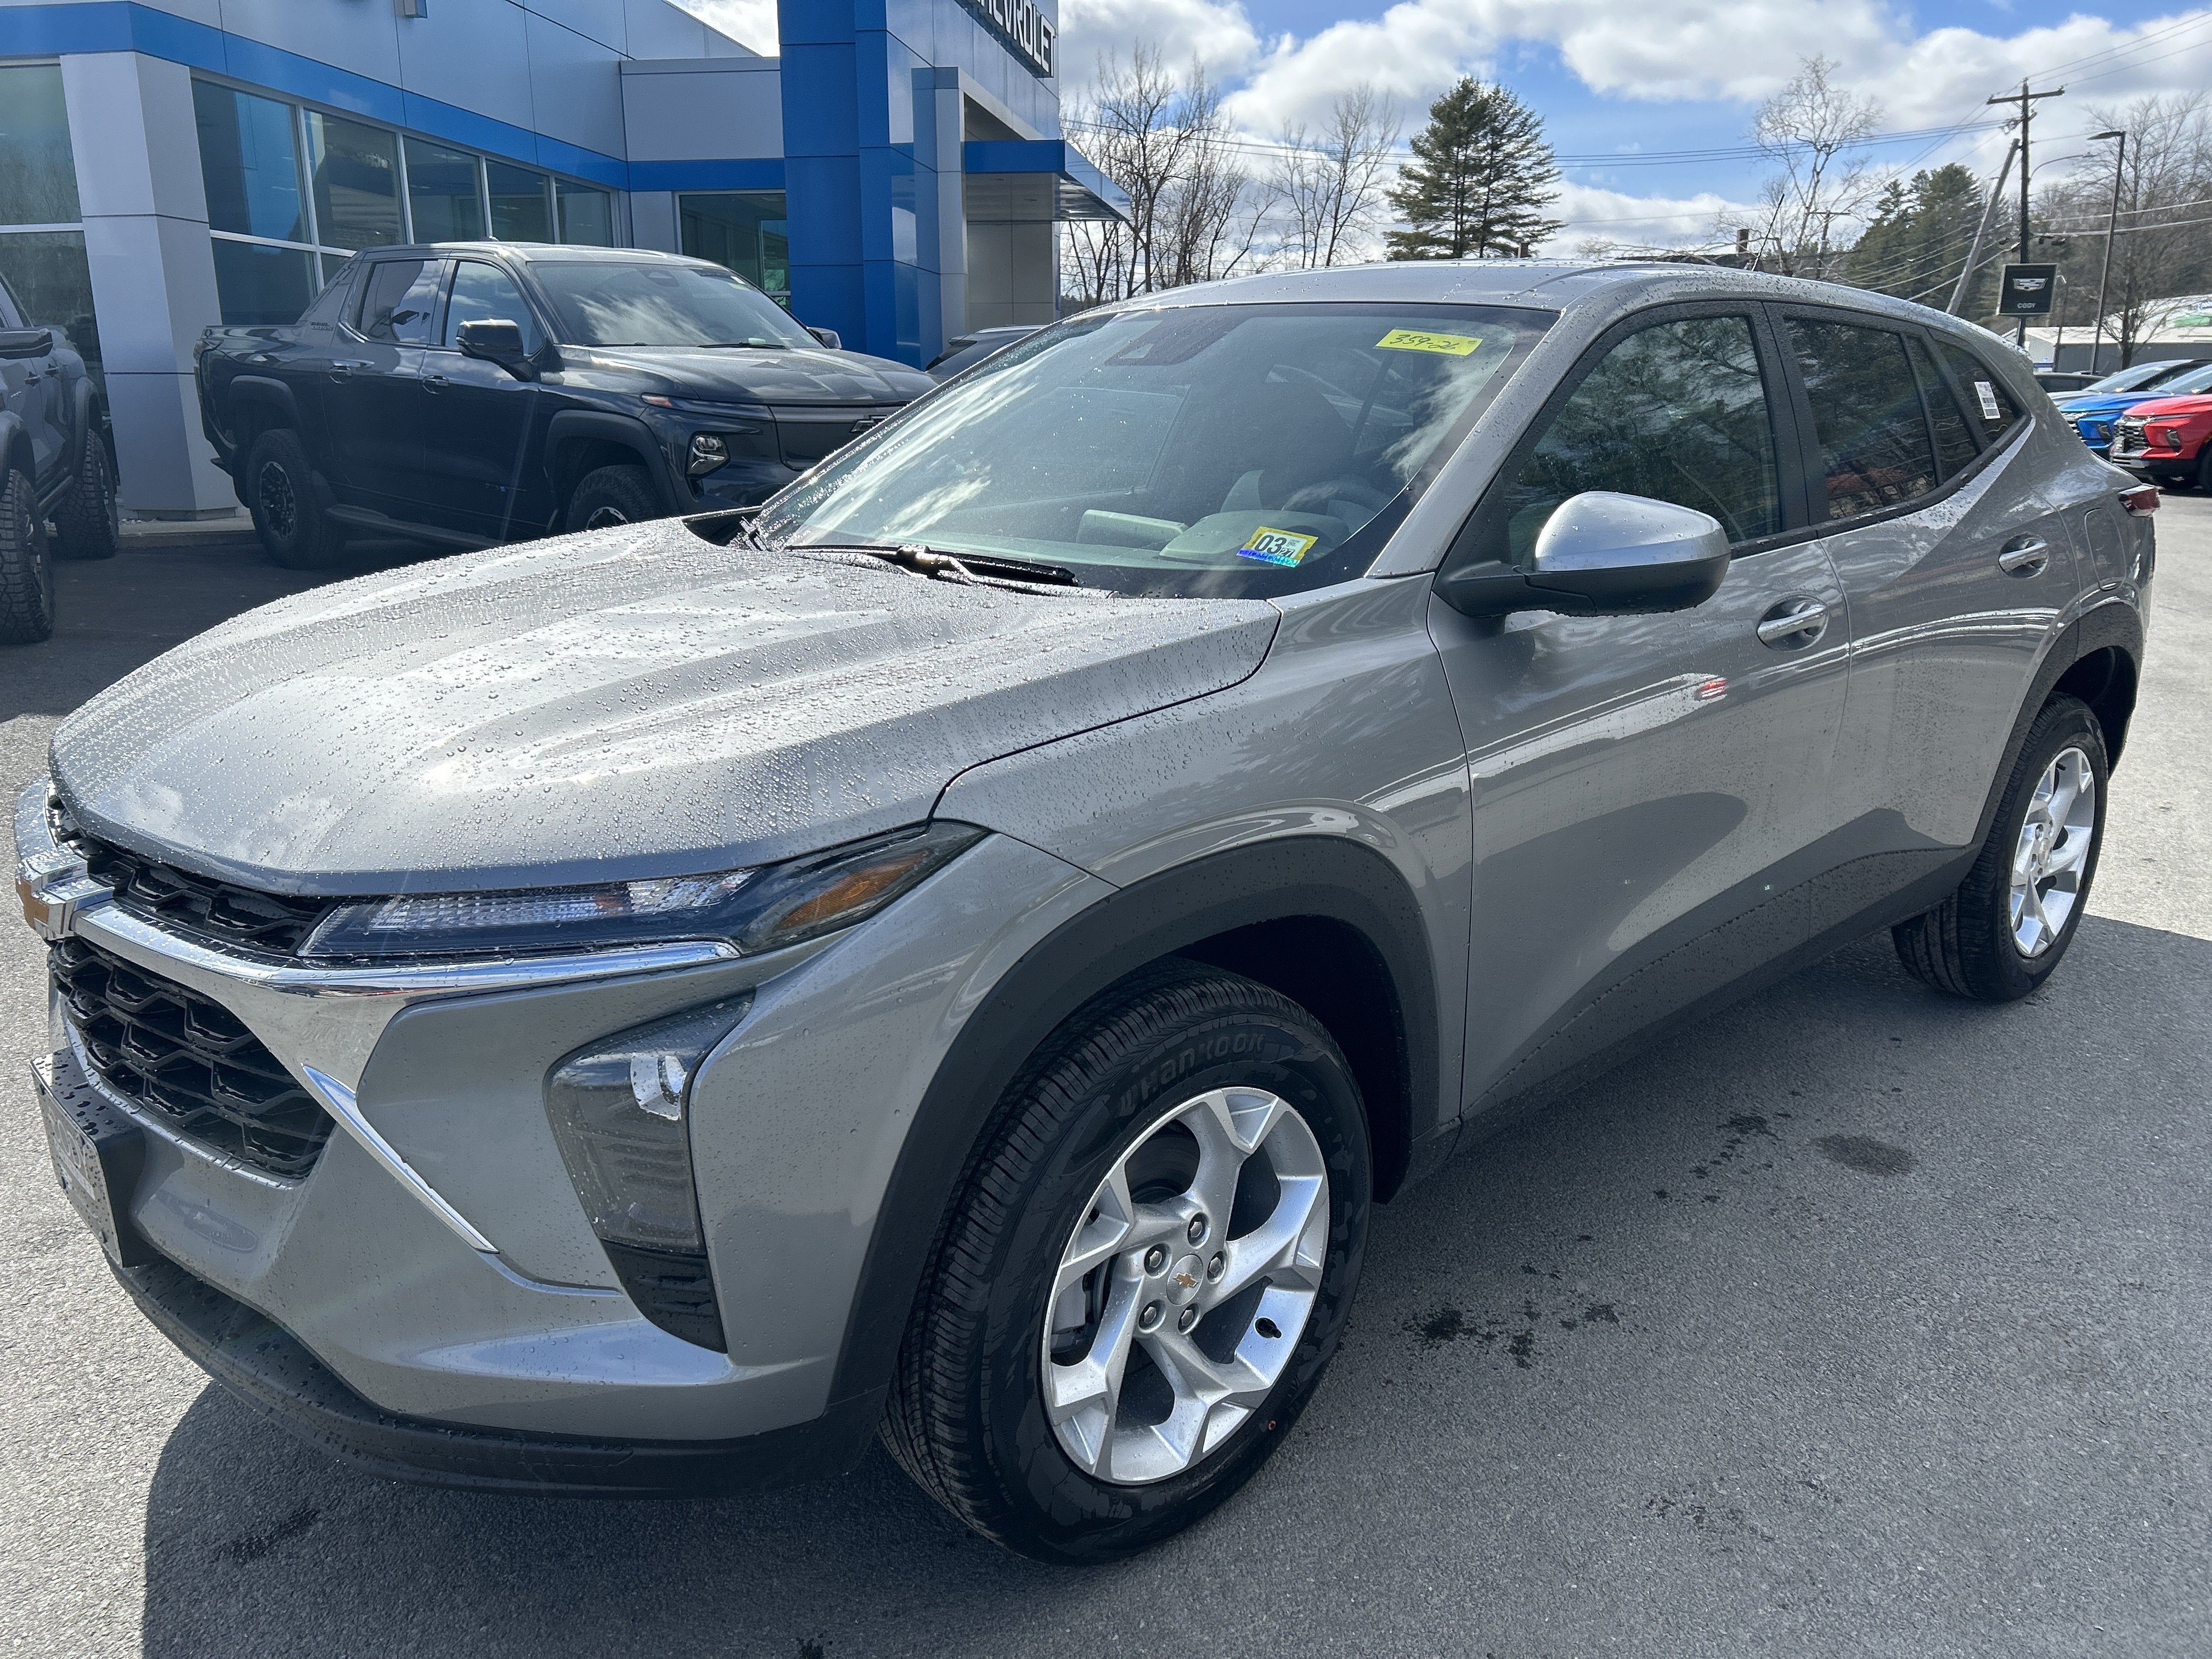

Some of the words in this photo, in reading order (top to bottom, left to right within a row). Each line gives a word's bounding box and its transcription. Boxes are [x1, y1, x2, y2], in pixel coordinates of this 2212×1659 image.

[977, 0, 1056, 78] VROLET
[1390, 334, 1460, 350] 359-26
[1254, 534, 1288, 554] 03
[1279, 548, 1295, 557] 27
